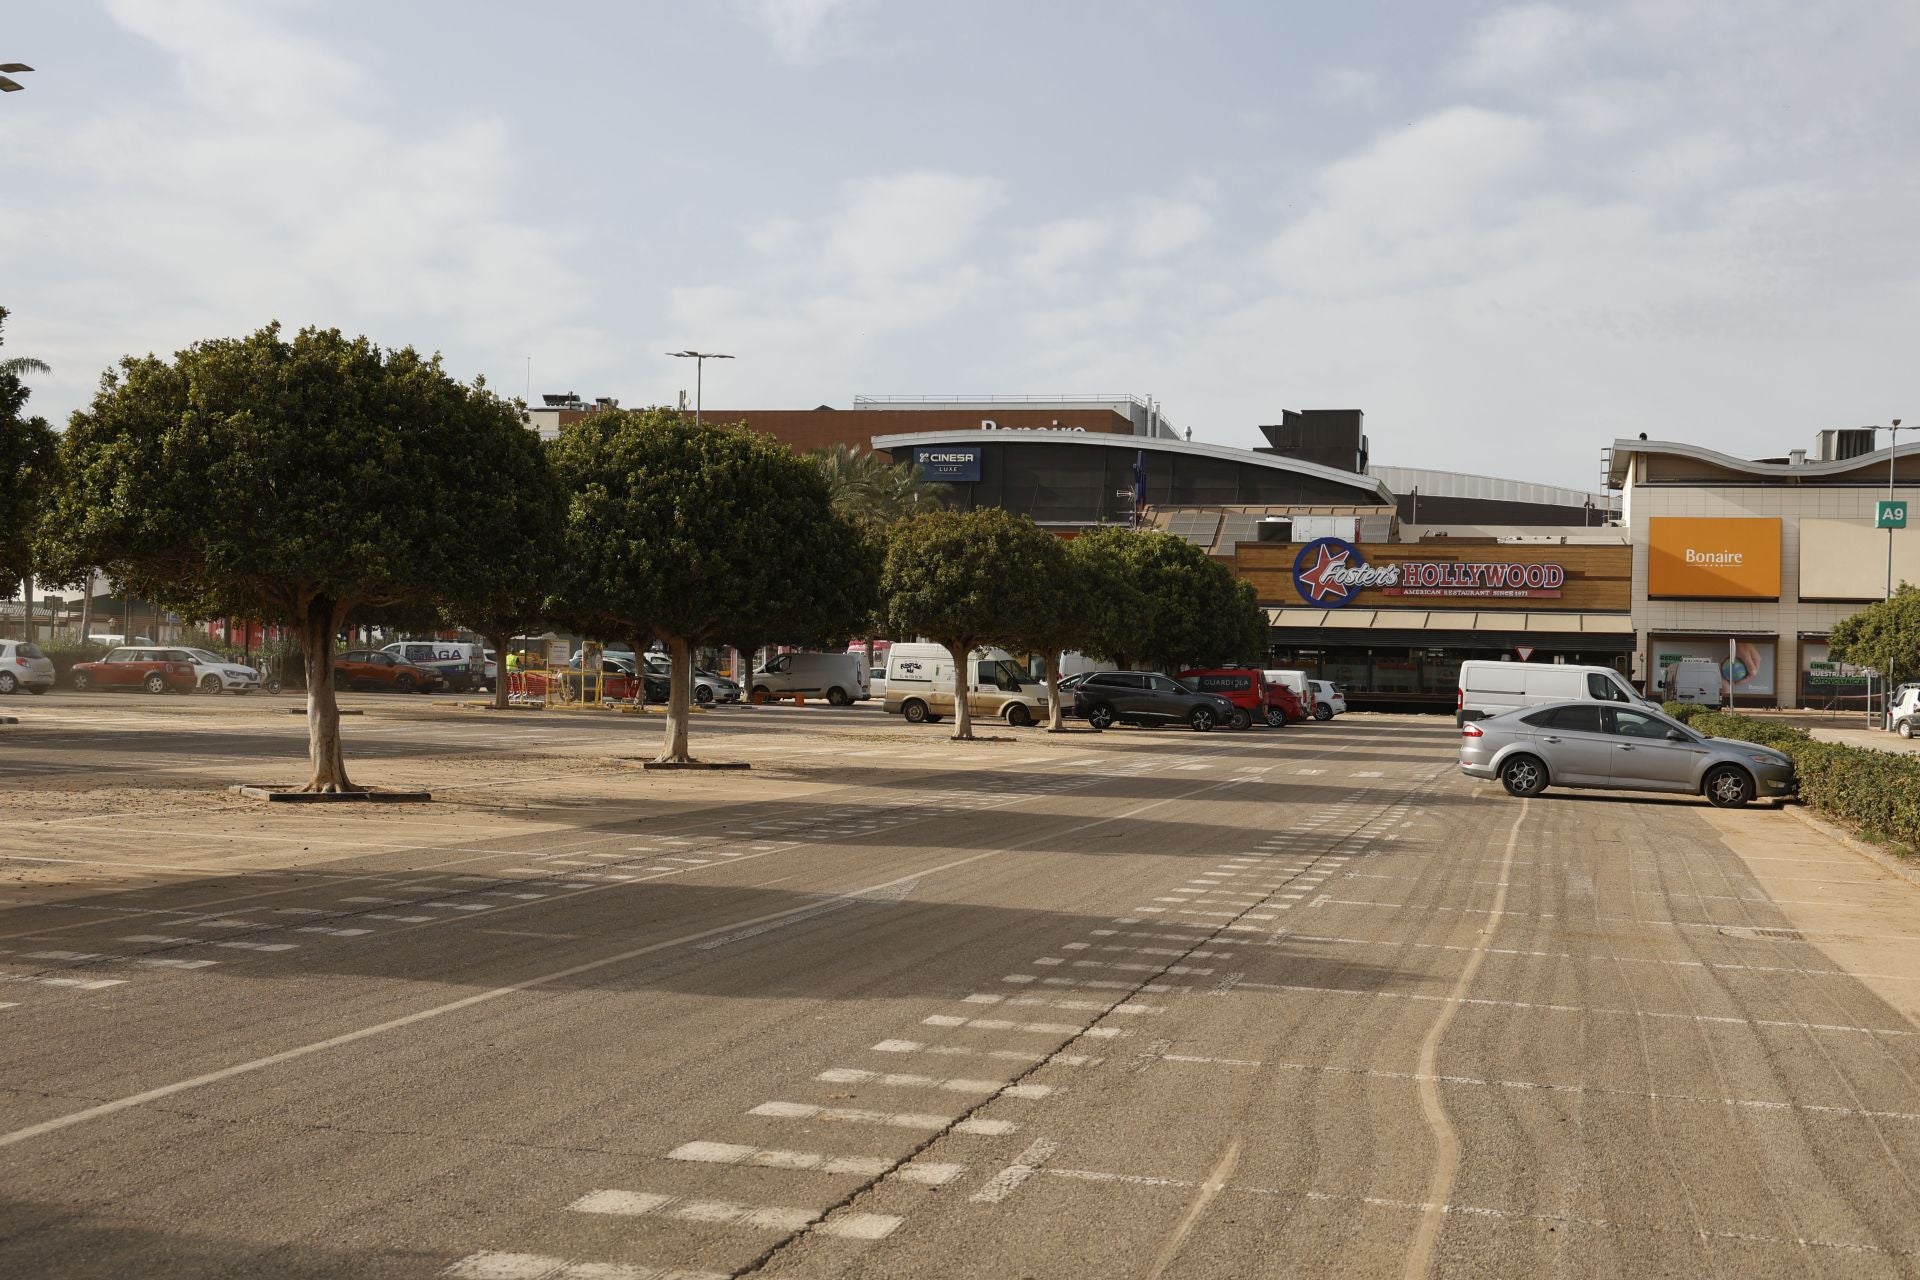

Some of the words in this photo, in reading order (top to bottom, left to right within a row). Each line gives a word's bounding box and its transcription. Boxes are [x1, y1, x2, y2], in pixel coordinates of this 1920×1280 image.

[930, 453, 974, 462] CINESA
[1882, 507, 1904, 520] A9
[1685, 549, 1743, 563] Bonaire
[1318, 560, 1400, 587] Foster's
[1402, 563, 1563, 587] HOLLYWOOD
